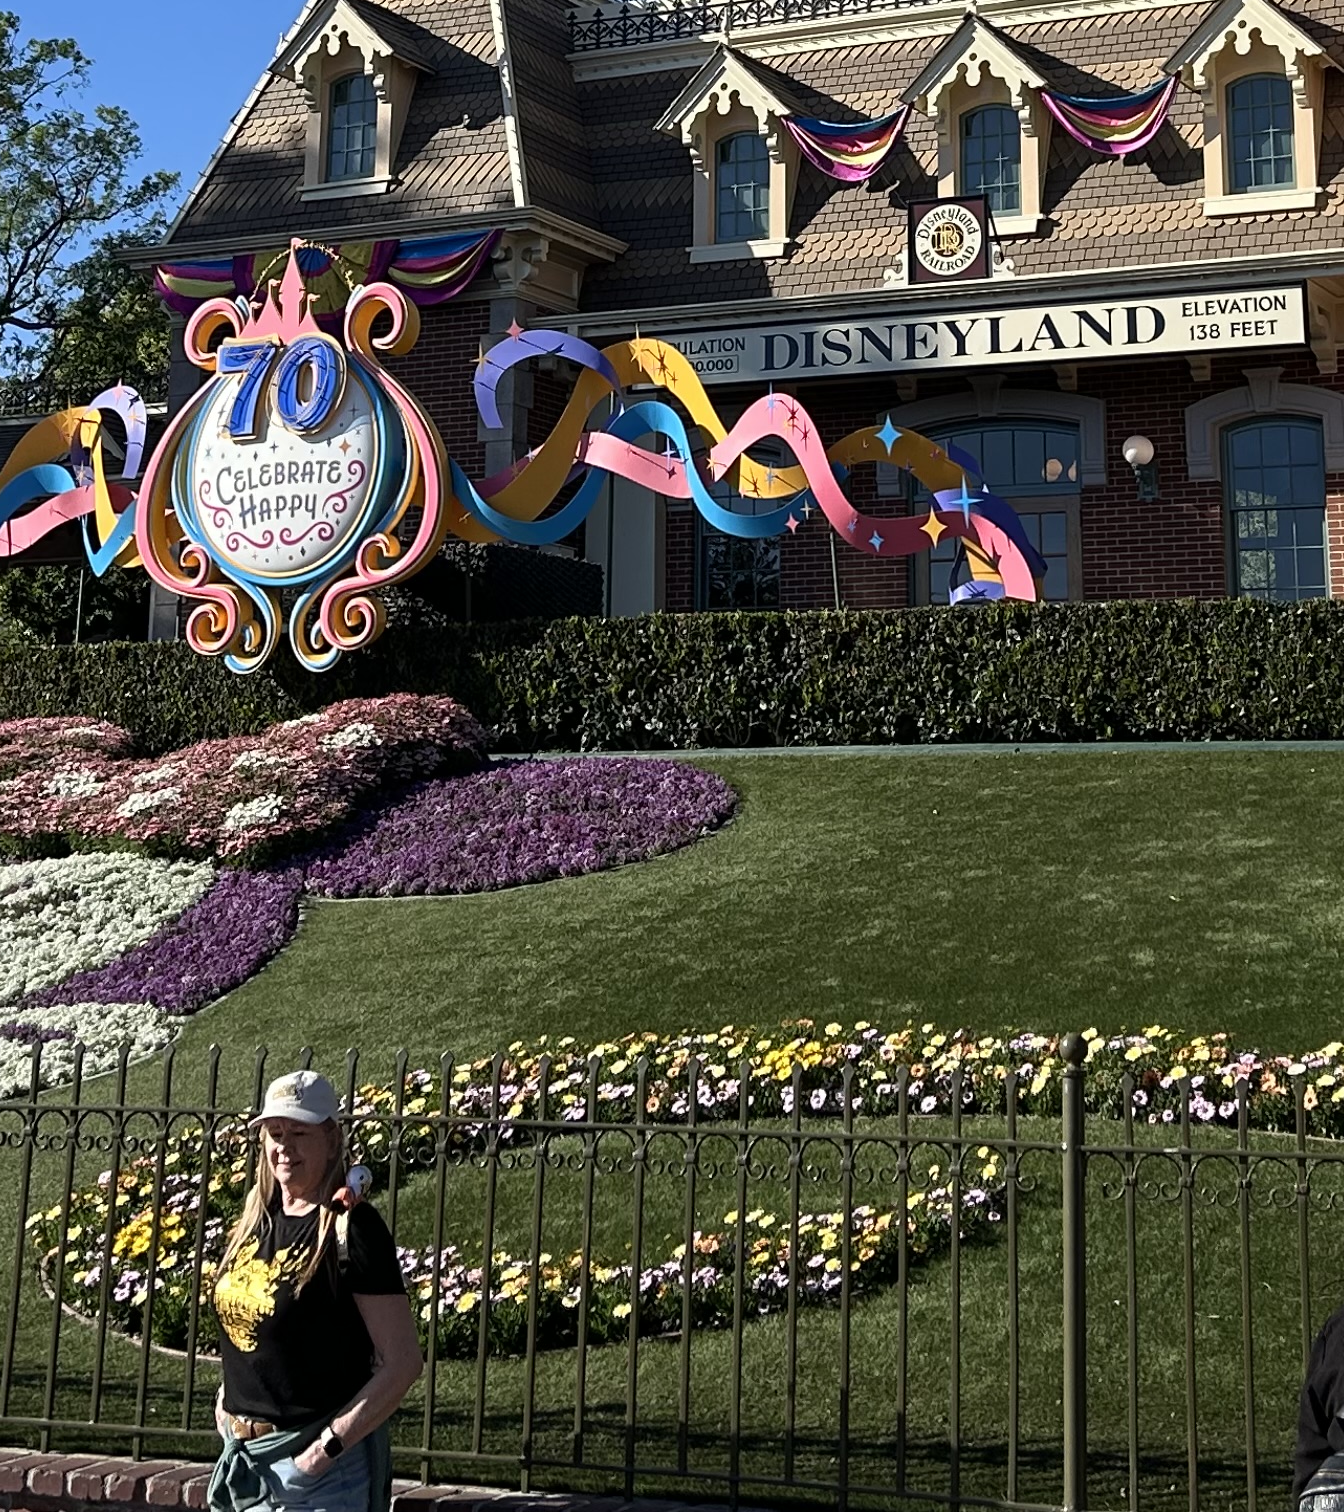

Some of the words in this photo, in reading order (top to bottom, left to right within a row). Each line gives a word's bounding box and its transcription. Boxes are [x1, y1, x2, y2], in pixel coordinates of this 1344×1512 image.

[917, 208, 979, 239] Disneyland
[920, 245, 975, 271] RAILROAD
[1181, 295, 1287, 317] ELEVATION
[668, 336, 746, 355] ULATION
[759, 305, 1166, 372] DISNEYLAND
[1189, 324, 1221, 341] 138
[1230, 320, 1278, 337] FEET
[217, 333, 346, 438] 70
[216, 460, 342, 505] CELEBRATE
[238, 493, 318, 529] HAPPY
